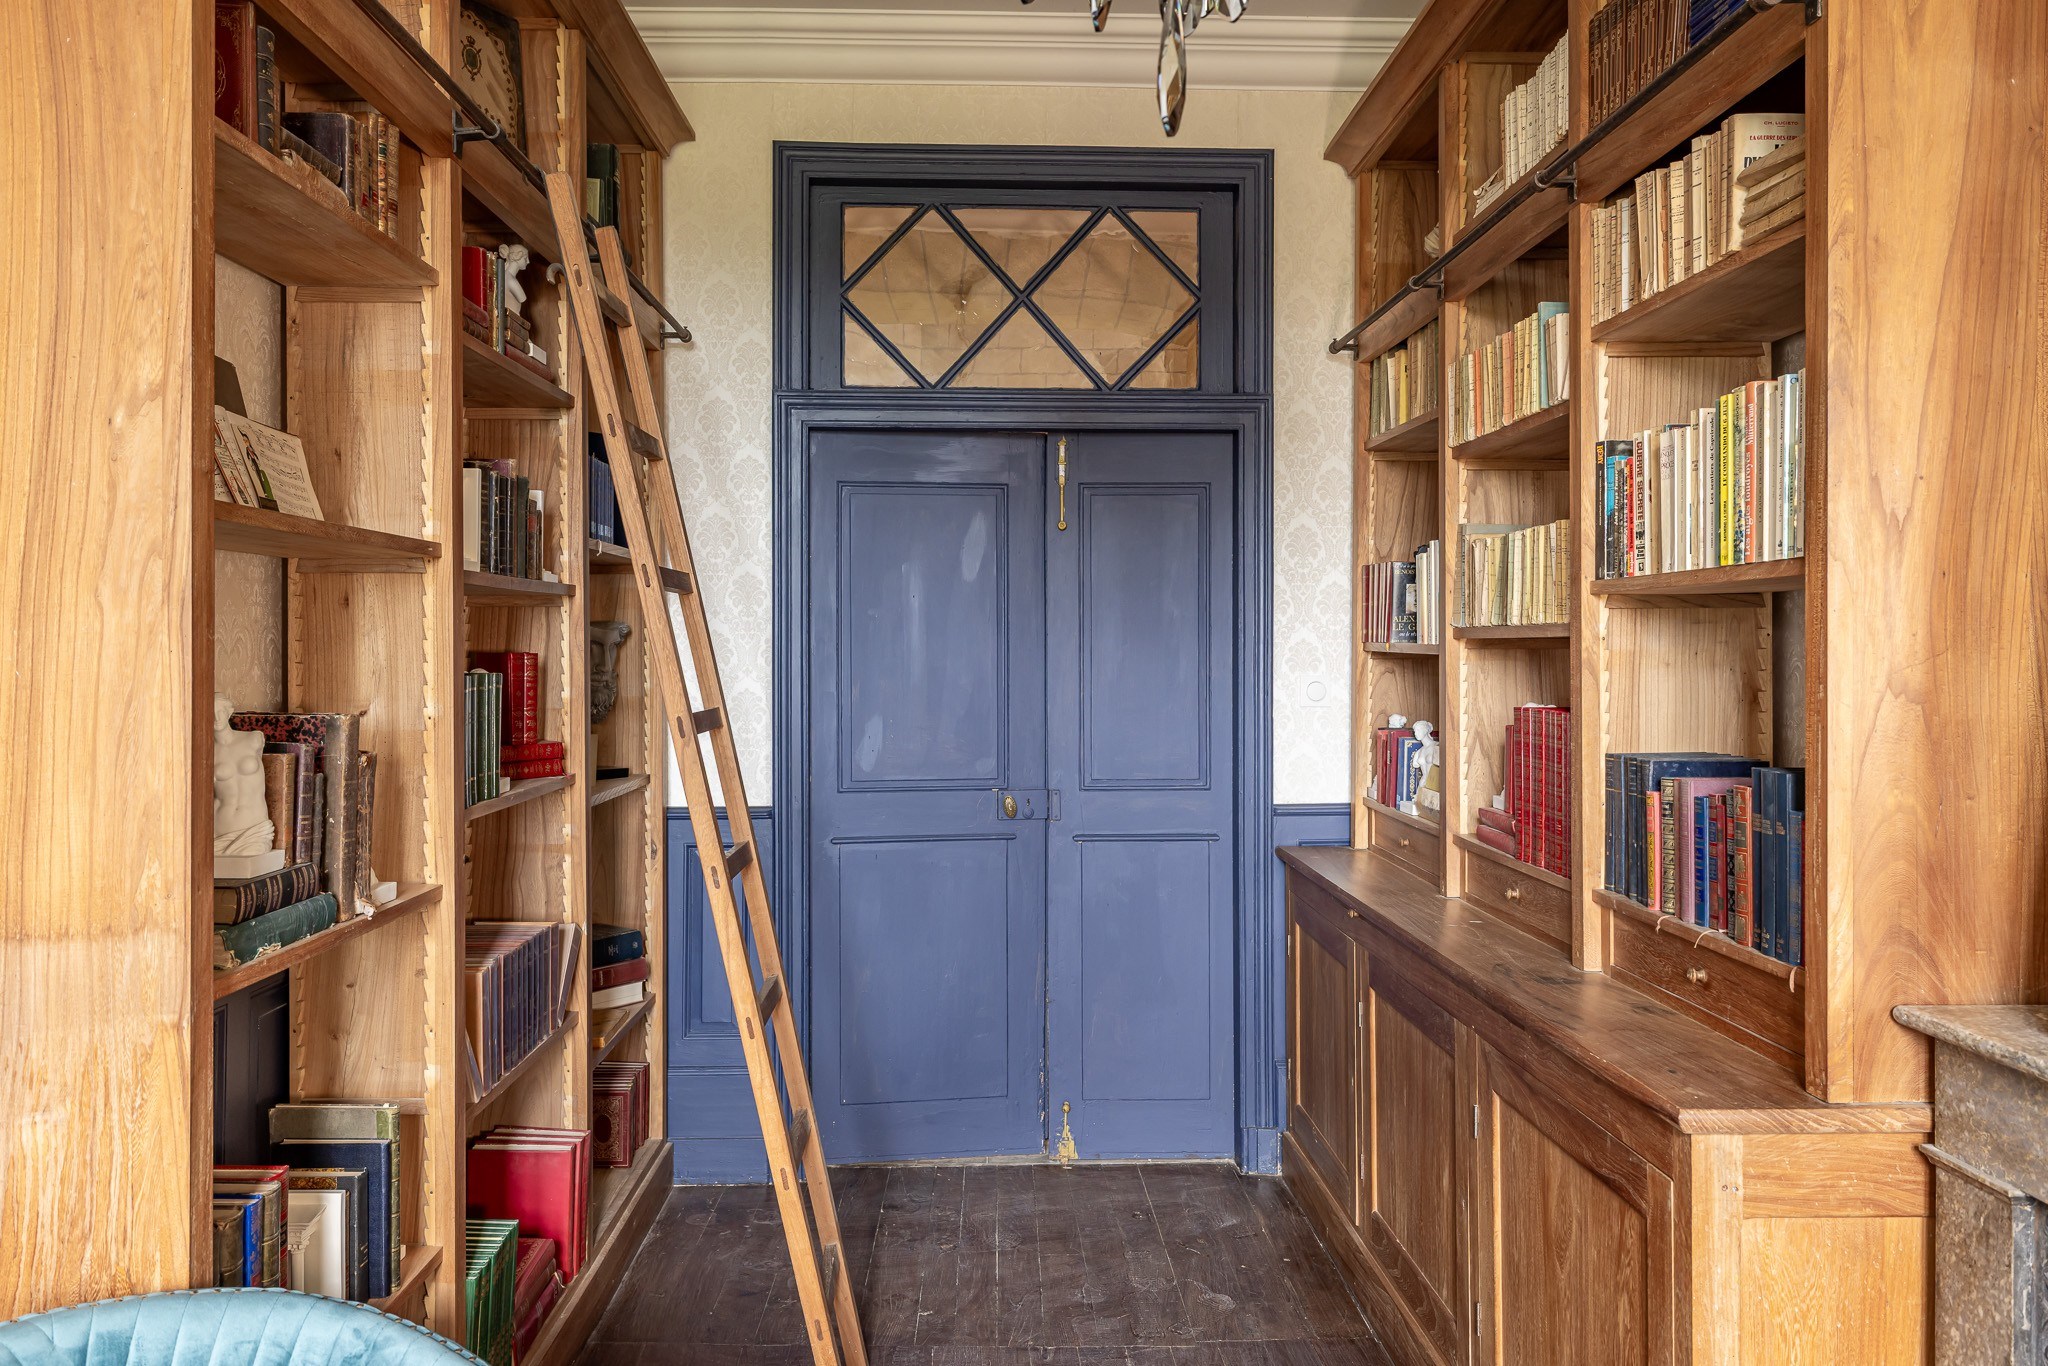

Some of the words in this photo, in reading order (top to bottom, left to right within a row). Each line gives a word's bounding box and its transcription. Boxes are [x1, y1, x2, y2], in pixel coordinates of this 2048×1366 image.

[1722, 426, 1728, 437] DU
[1722, 478, 1728, 487] LE
[1637, 480, 1645, 520] SECRETE
[1745, 504, 1754, 535] aigles
